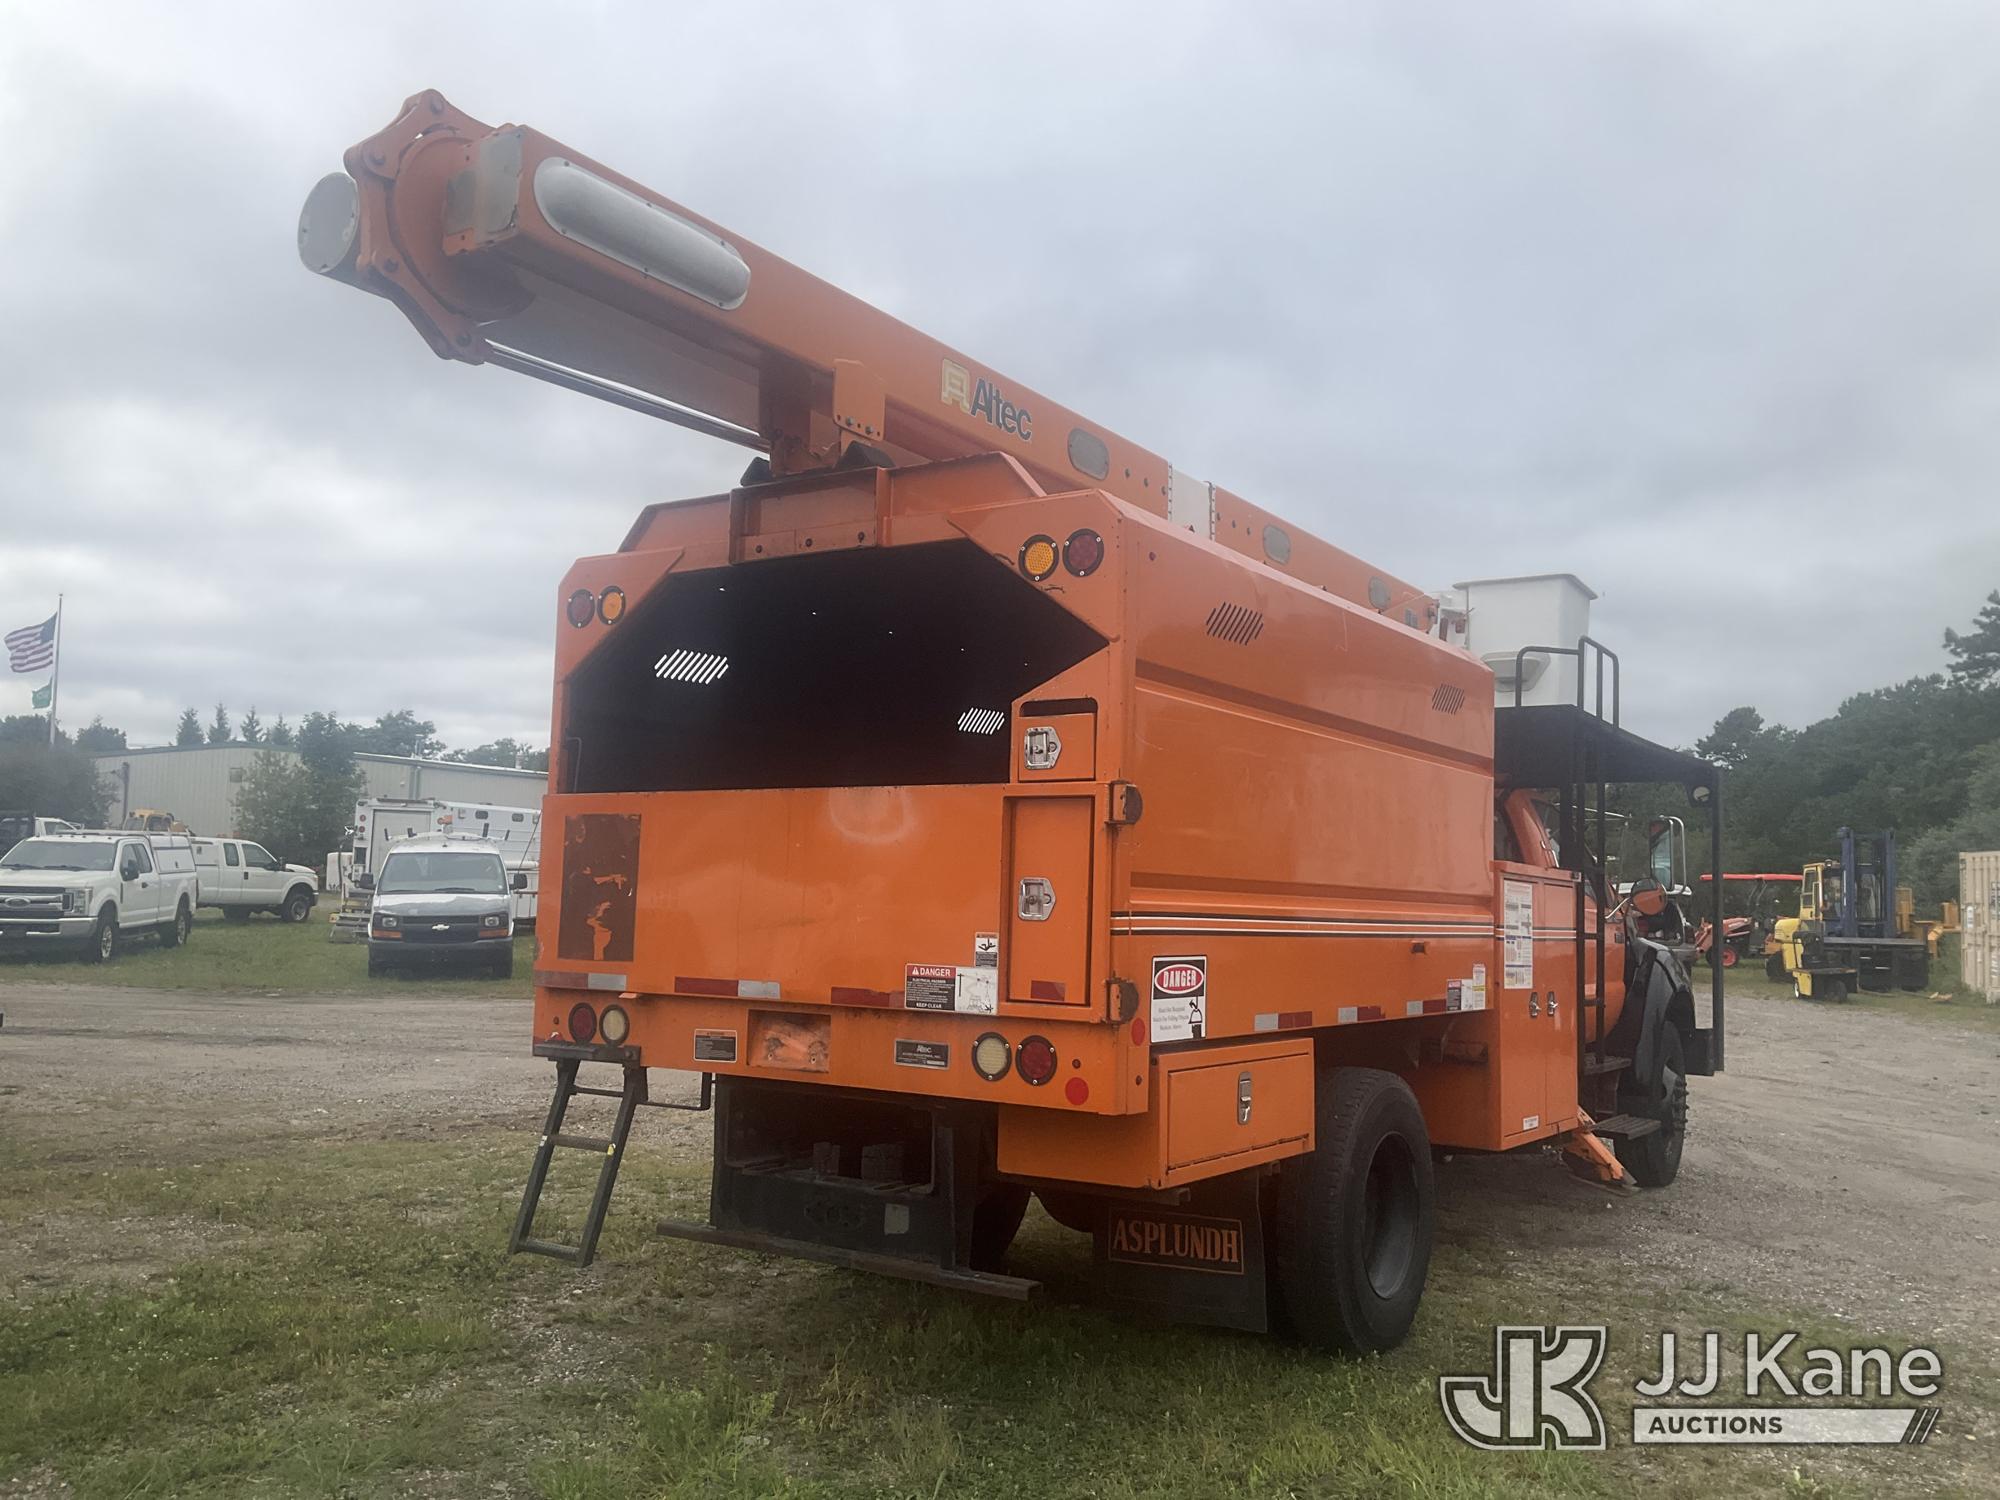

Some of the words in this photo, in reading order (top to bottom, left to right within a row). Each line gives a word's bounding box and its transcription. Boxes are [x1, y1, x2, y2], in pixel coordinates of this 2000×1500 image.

[970, 377, 1032, 441] Altec
[919, 967, 951, 977] DANGER
[1163, 970, 1197, 988] DANGER
[1112, 1218, 1239, 1263] ASPLUNDH
